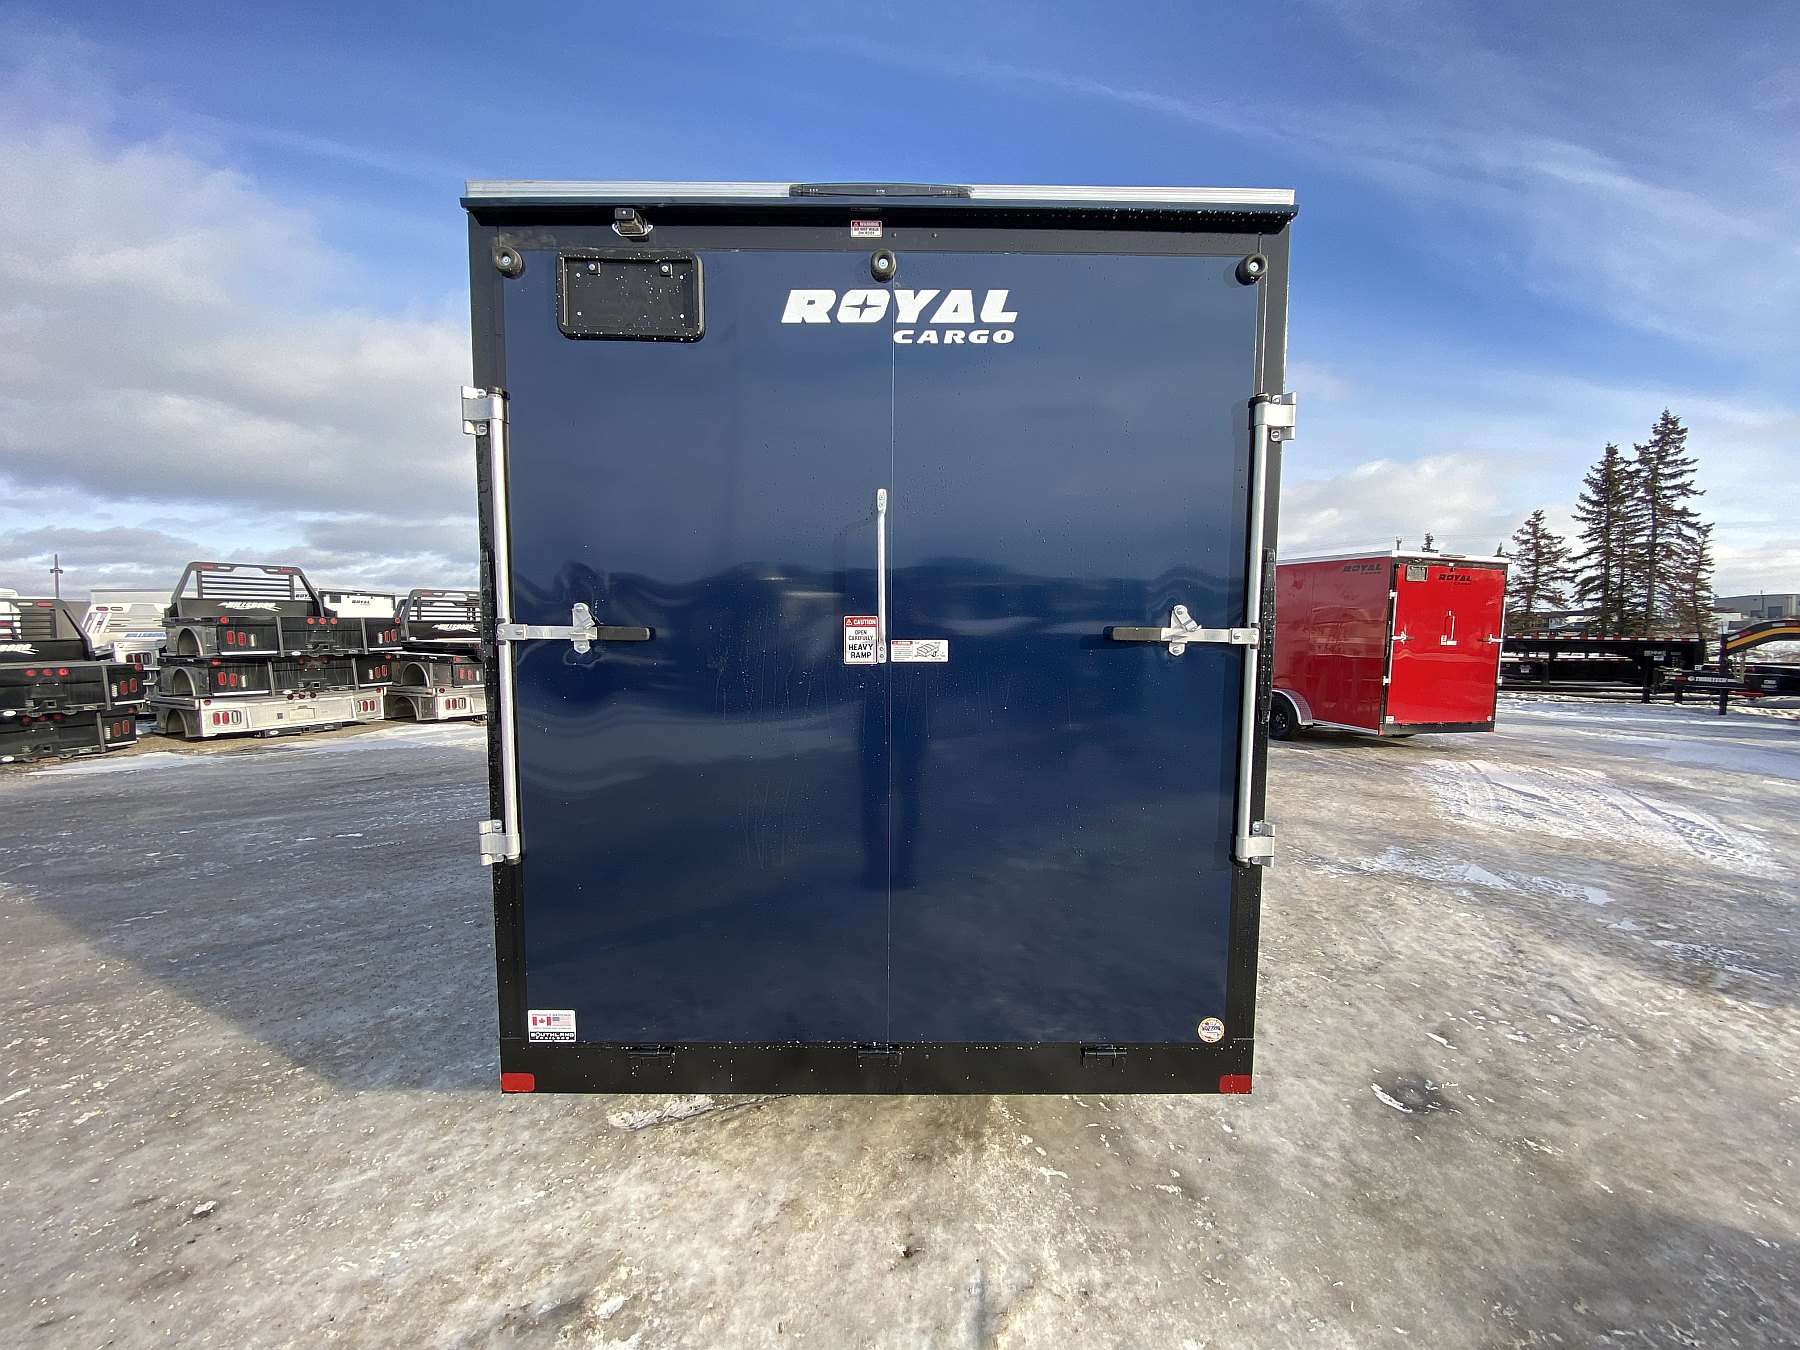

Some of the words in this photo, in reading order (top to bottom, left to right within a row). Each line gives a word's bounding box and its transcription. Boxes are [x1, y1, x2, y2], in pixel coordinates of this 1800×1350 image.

[781, 289, 1018, 323] ROYAL
[893, 329, 1015, 344] CARGO
[1343, 563, 1382, 573] ROYAL
